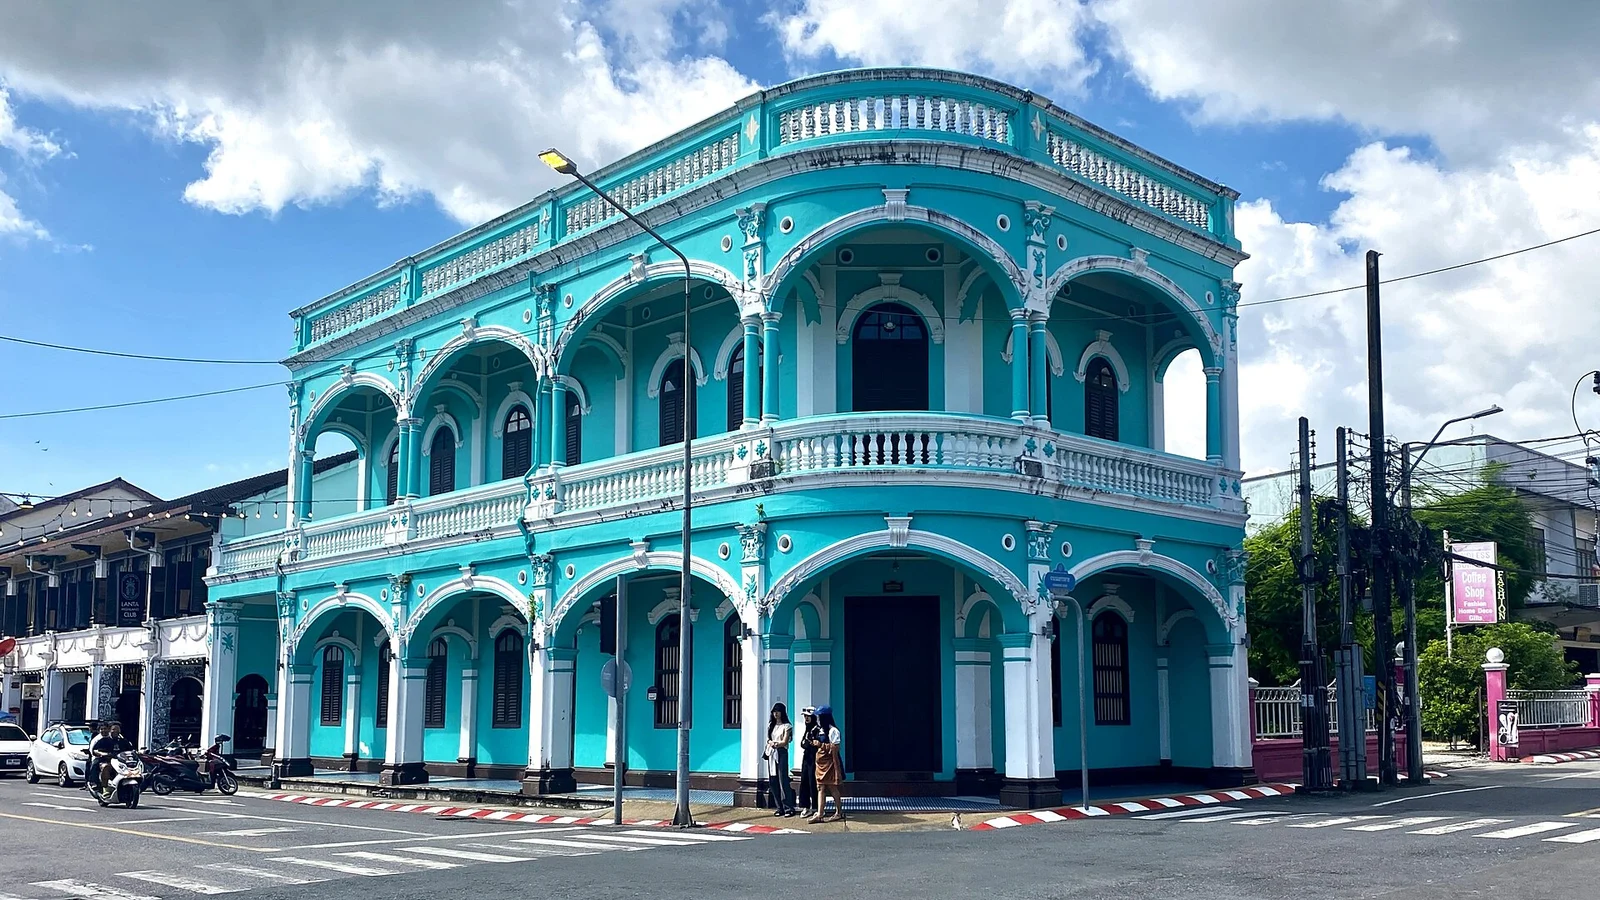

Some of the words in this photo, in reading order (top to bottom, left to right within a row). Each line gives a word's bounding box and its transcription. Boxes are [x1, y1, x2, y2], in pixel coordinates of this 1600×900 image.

[1462, 571, 1487, 583] Coffee
[1465, 586, 1485, 600] Shop
[1497, 570, 1506, 620] FASHION
